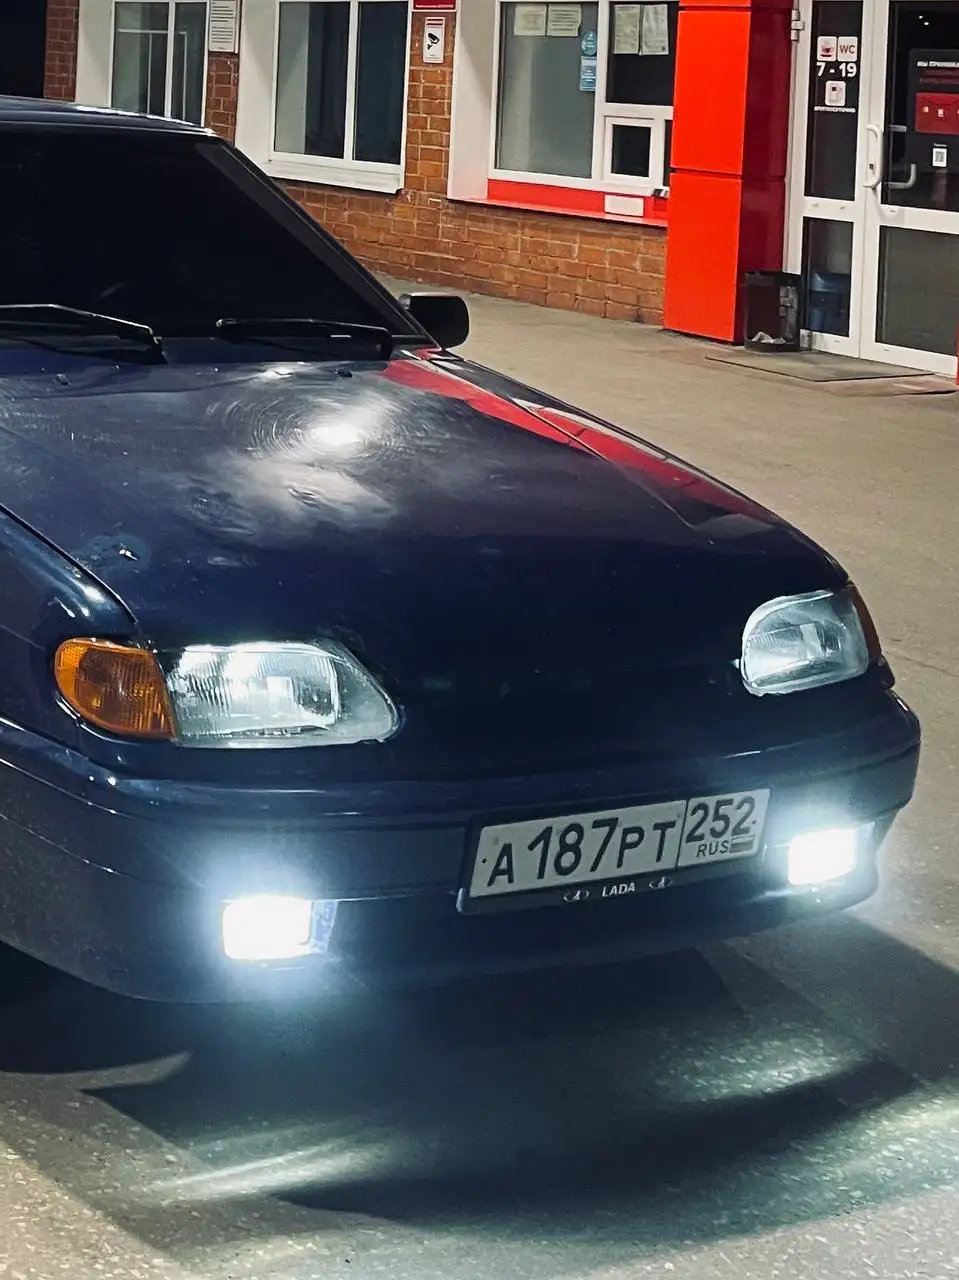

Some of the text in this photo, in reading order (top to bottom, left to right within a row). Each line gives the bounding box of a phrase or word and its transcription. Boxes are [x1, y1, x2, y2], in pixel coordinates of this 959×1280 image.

[840, 45, 855, 54] WC
[816, 62, 826, 77] 7
[839, 63, 857, 77] 19
[685, 795, 755, 843] 252
[696, 842, 730, 858] RUS
[602, 882, 637, 898] LADA
